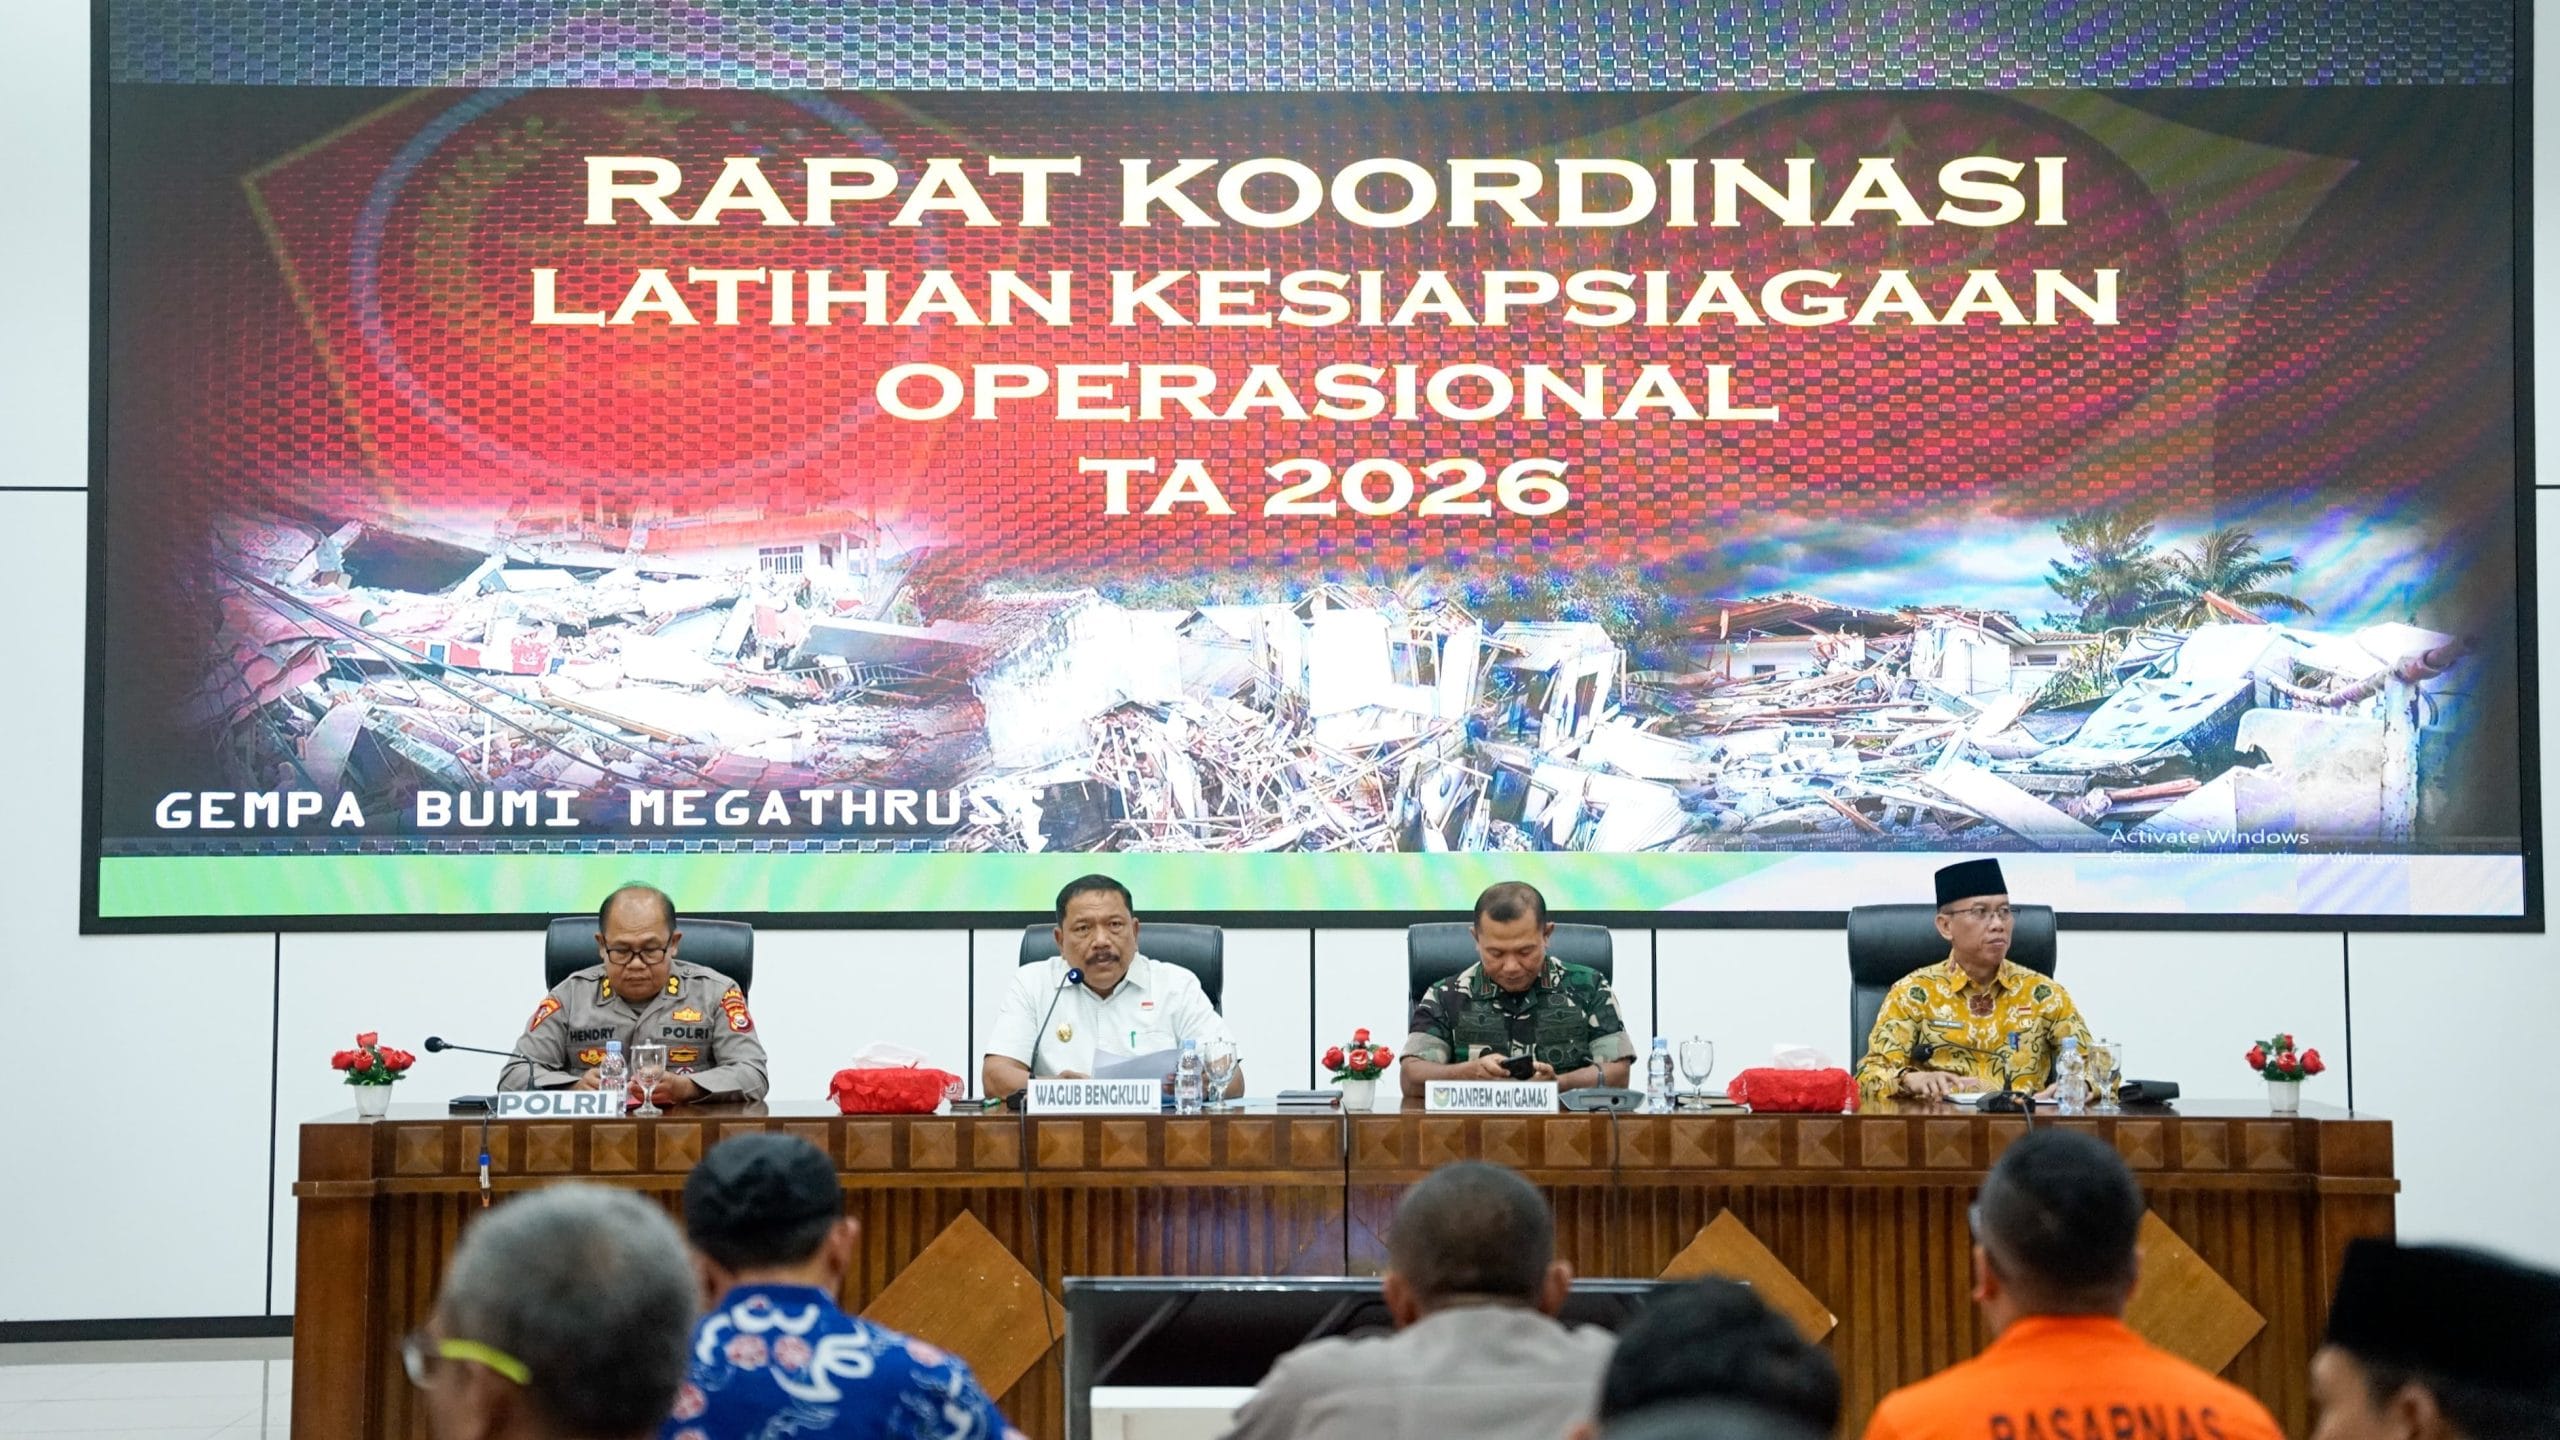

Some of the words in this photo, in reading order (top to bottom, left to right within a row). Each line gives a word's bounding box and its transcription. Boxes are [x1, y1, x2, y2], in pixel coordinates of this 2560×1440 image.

[584, 155, 1082, 226] RAPAT
[1119, 156, 2067, 228] KOORDINASI
[531, 267, 1073, 327] LATIHAN
[1110, 268, 2120, 328] KESIAPSIAGAAN
[875, 361, 1780, 423] OPERASIONAL
[1078, 456, 1235, 515] TA
[1263, 457, 1570, 517] 2026
[155, 791, 366, 829] GEMPA
[417, 790, 581, 827] BUMI
[2110, 828, 2200, 844] Activate
[2206, 828, 2310, 844] Windows
[569, 1027, 615, 1042] HENDRY
[662, 1027, 709, 1039] POLRI
[499, 1093, 607, 1115] POLRI
[1035, 1084, 1082, 1106] WAGUB
[1085, 1084, 1151, 1106] BENGKULU
[1450, 1087, 1493, 1108] DANREM
[1495, 1087, 1548, 1108] 041/GAMAS
